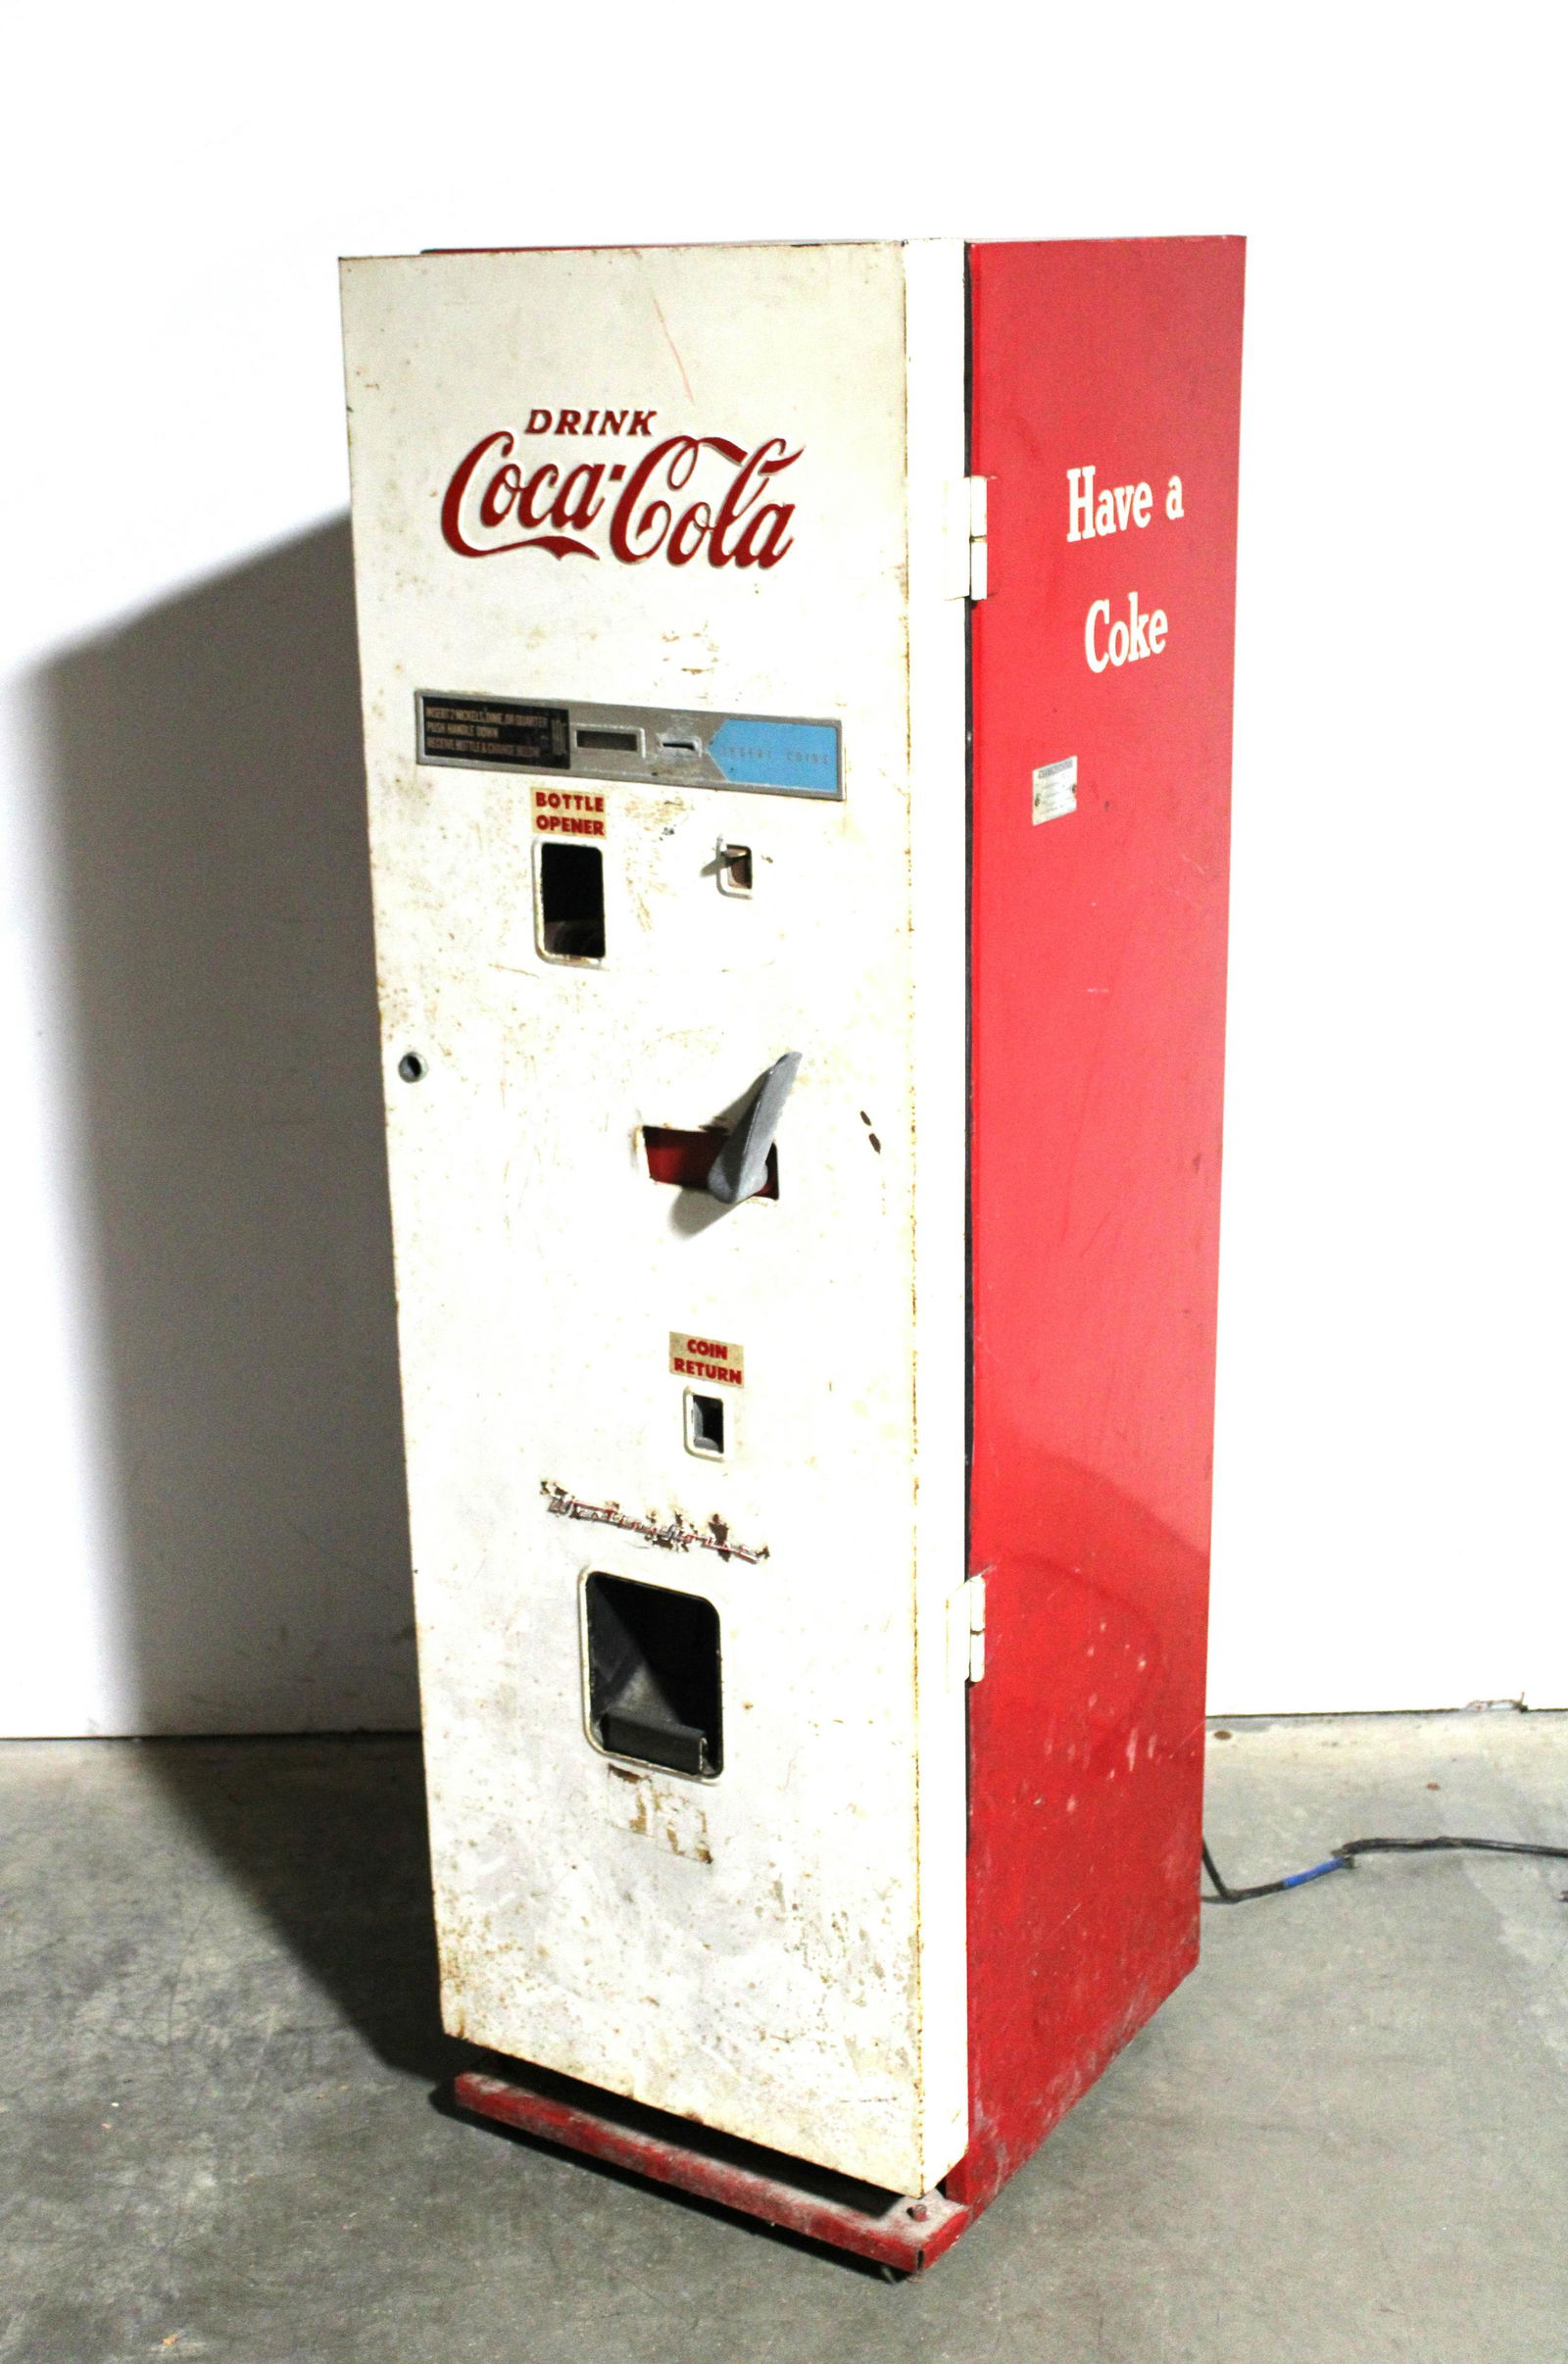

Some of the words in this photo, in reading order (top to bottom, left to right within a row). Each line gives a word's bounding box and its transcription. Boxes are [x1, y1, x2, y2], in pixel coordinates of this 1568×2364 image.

[524, 409, 658, 436] DRINK
[440, 431, 806, 570] Coca-Cola
[1066, 465, 1153, 543] Have
[1166, 474, 1185, 520] a
[1085, 591, 1168, 673] Coke
[535, 791, 605, 813] BOTTLE
[535, 814, 606, 836] OPENER
[687, 1339, 728, 1360] COIN
[673, 1356, 742, 1385] RETURN
